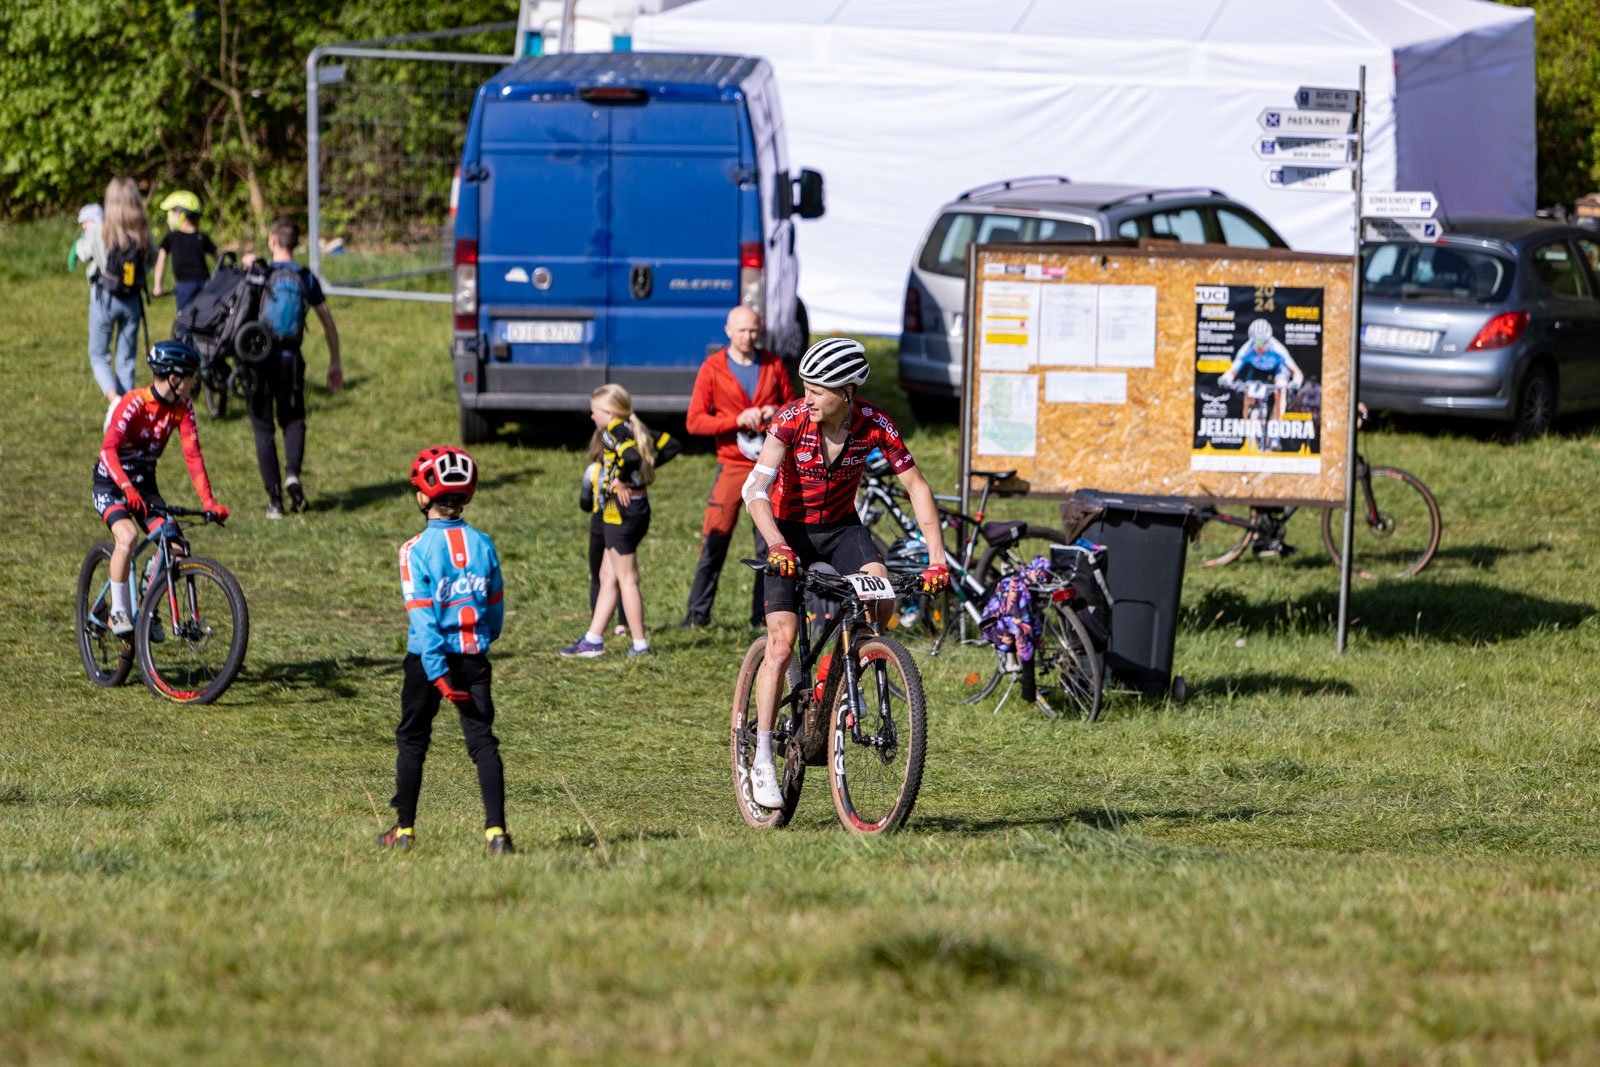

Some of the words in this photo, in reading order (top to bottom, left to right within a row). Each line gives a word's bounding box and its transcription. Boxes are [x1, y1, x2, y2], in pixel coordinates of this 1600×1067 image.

[1287, 115, 1313, 126] PASTA
[1314, 116, 1341, 126] PARTY
[1201, 291, 1228, 300] UCI
[1254, 286, 1275, 298] 20
[1254, 299, 1275, 312] 24
[778, 403, 809, 426] JBG2
[872, 413, 899, 440] JBG2
[855, 576, 886, 592] 268
